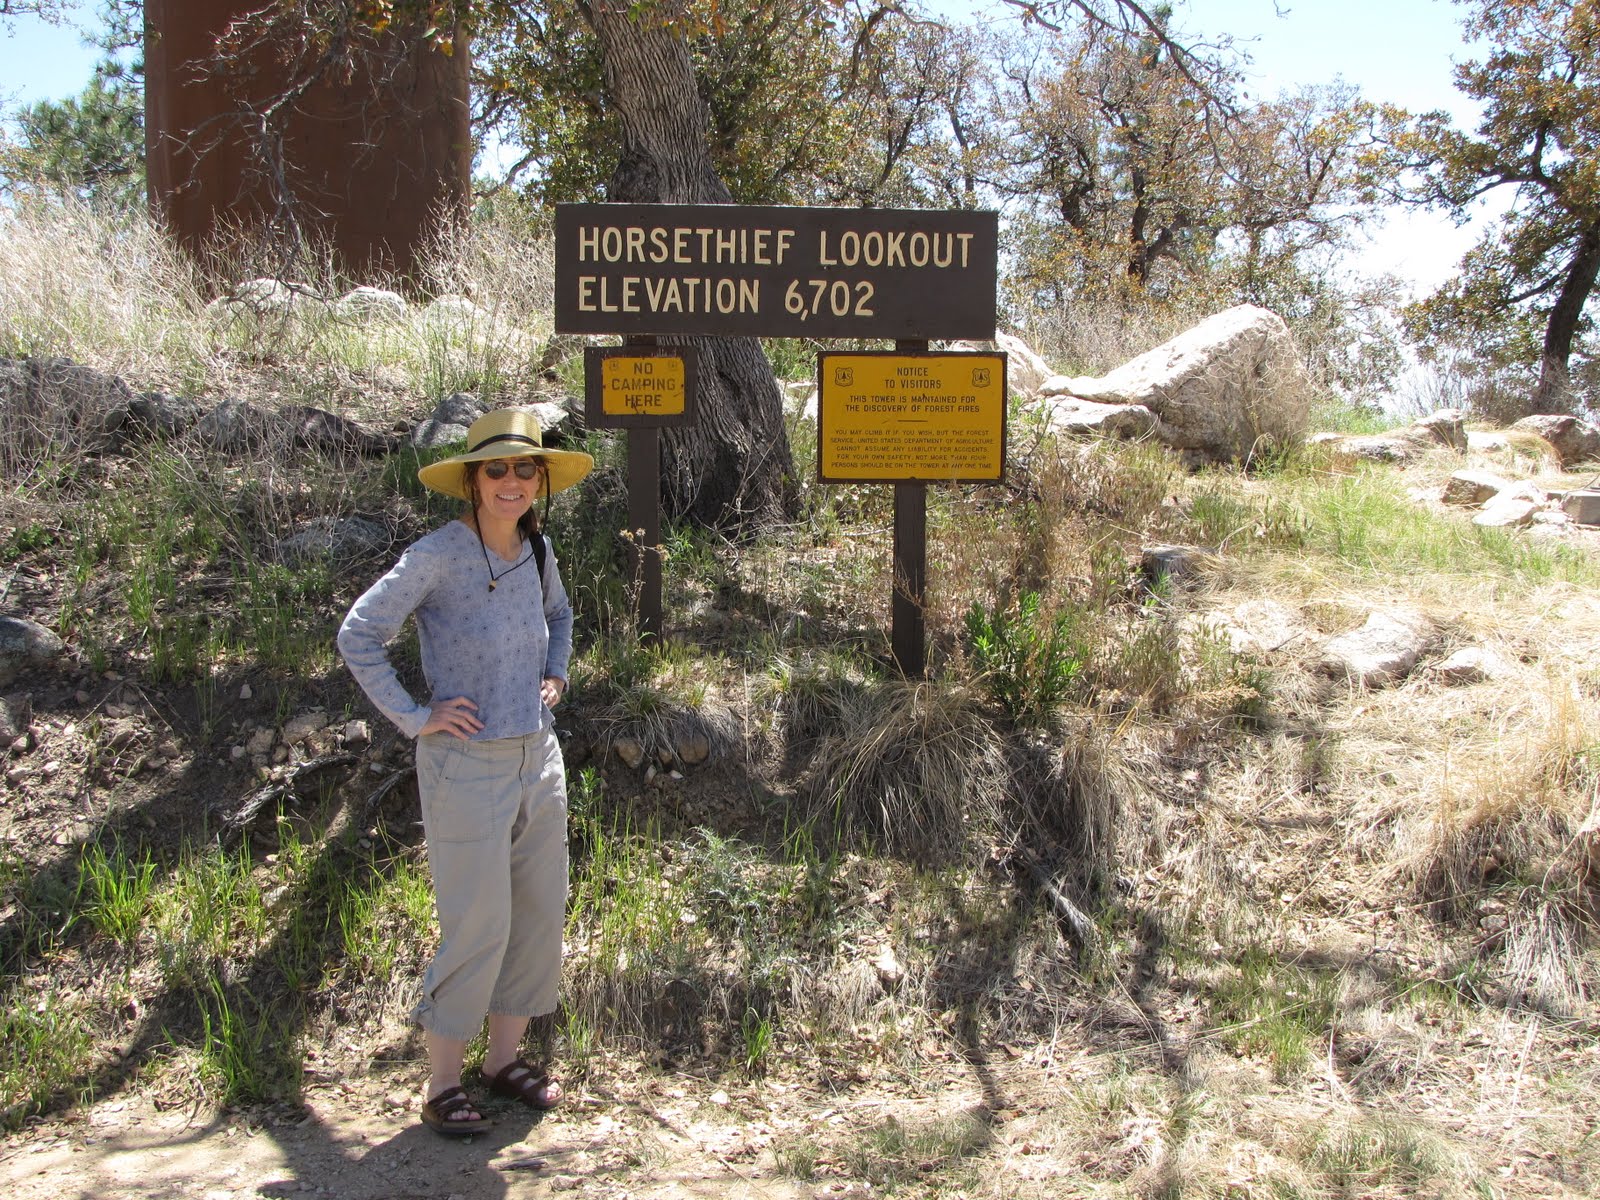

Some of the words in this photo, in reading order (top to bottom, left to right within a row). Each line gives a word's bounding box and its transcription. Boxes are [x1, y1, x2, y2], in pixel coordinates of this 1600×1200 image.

[578, 226, 795, 265] HORSETHIEF
[819, 230, 974, 267] LOOKOUT
[578, 276, 760, 314] ELEVATION
[784, 279, 875, 321] 6,702
[633, 362, 653, 374] NO
[897, 367, 929, 377] NOTICE
[611, 378, 676, 390] CAMPING
[884, 379, 896, 389] TO
[900, 379, 942, 389] VISITORS
[625, 394, 662, 407] HERE
[849, 395, 867, 403] THIS
[871, 395, 896, 403] TOWER
[899, 395, 907, 403] IS
[911, 395, 957, 404] MAINTAINED
[960, 396, 976, 404] FOR
[846, 404, 860, 412] THE
[863, 404, 907, 412] DISCOVERY
[911, 405, 921, 413] OF
[925, 405, 955, 413] FOREST
[957, 405, 980, 413] FIRES
